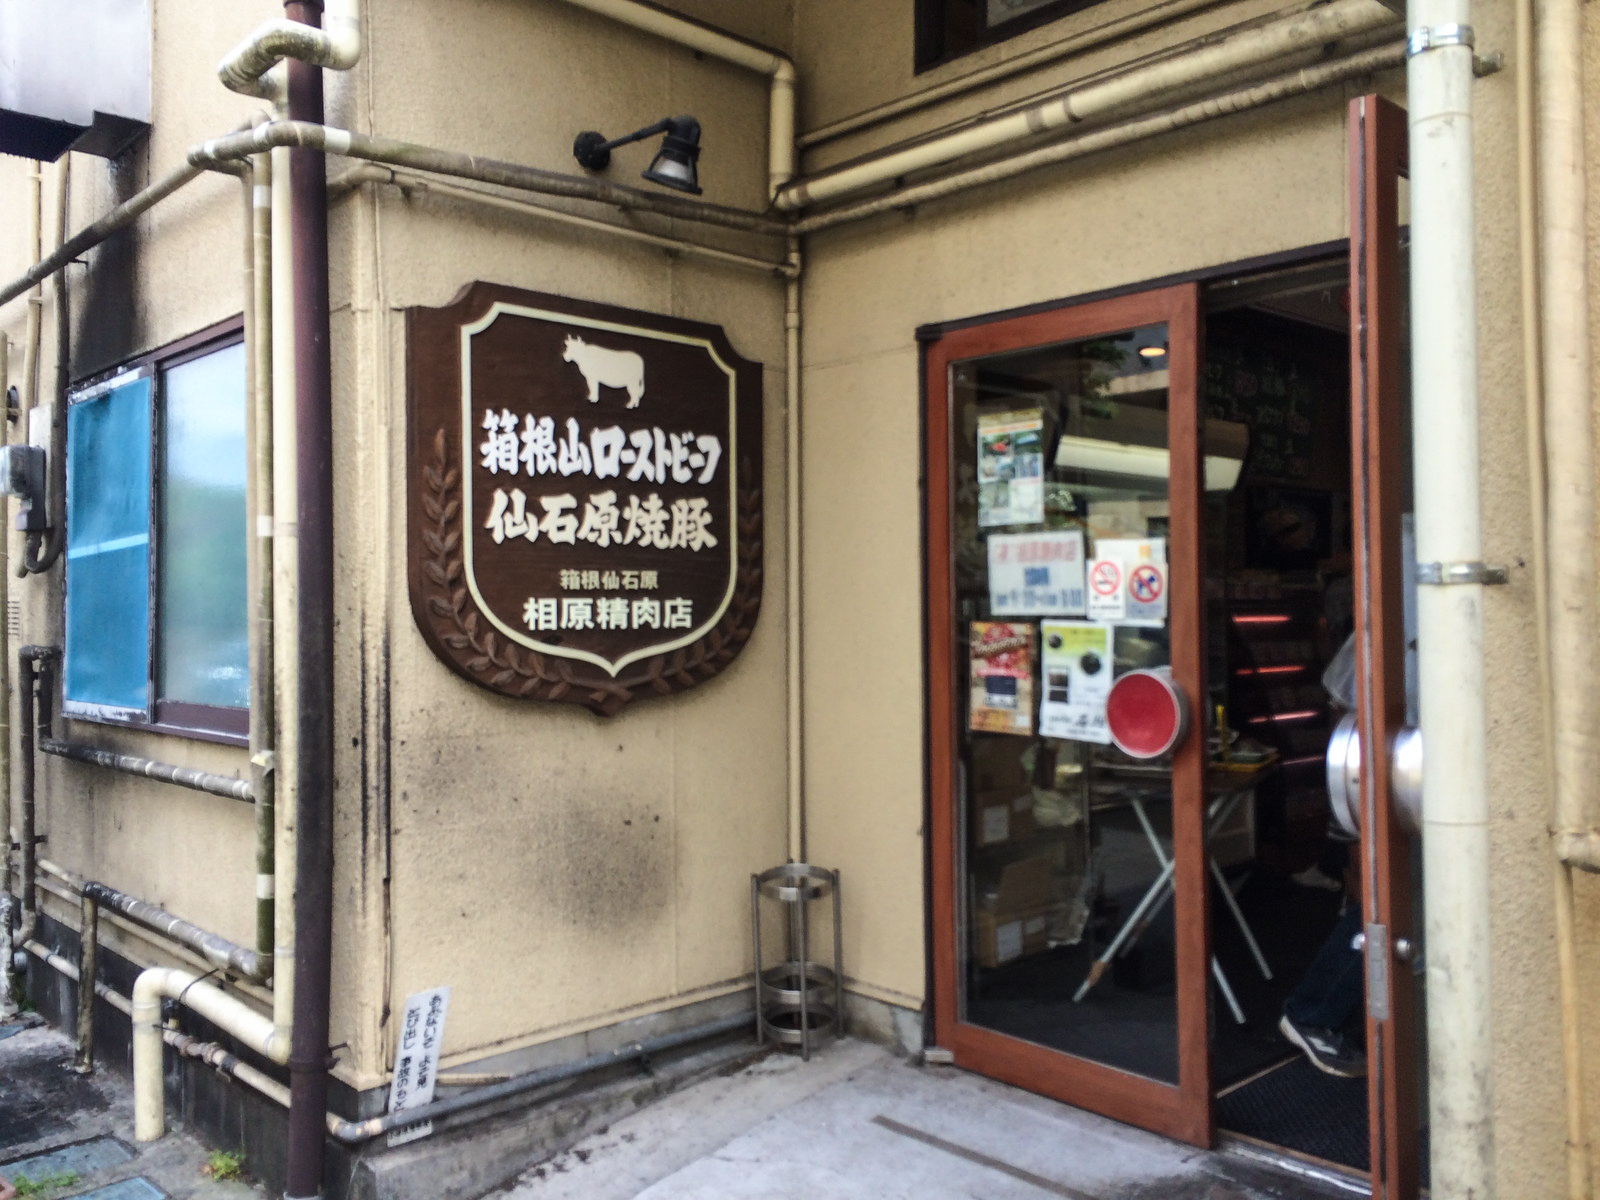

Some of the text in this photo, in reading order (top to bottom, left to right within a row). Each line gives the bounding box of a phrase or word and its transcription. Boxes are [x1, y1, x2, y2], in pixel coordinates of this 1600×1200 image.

[479, 408, 722, 485] 箱根山ローストビーフ
[484, 487, 718, 552] 仙石原焼豚
[559, 568, 658, 590] 箱根仙石原
[522, 596, 693, 631] 相原精肉店
